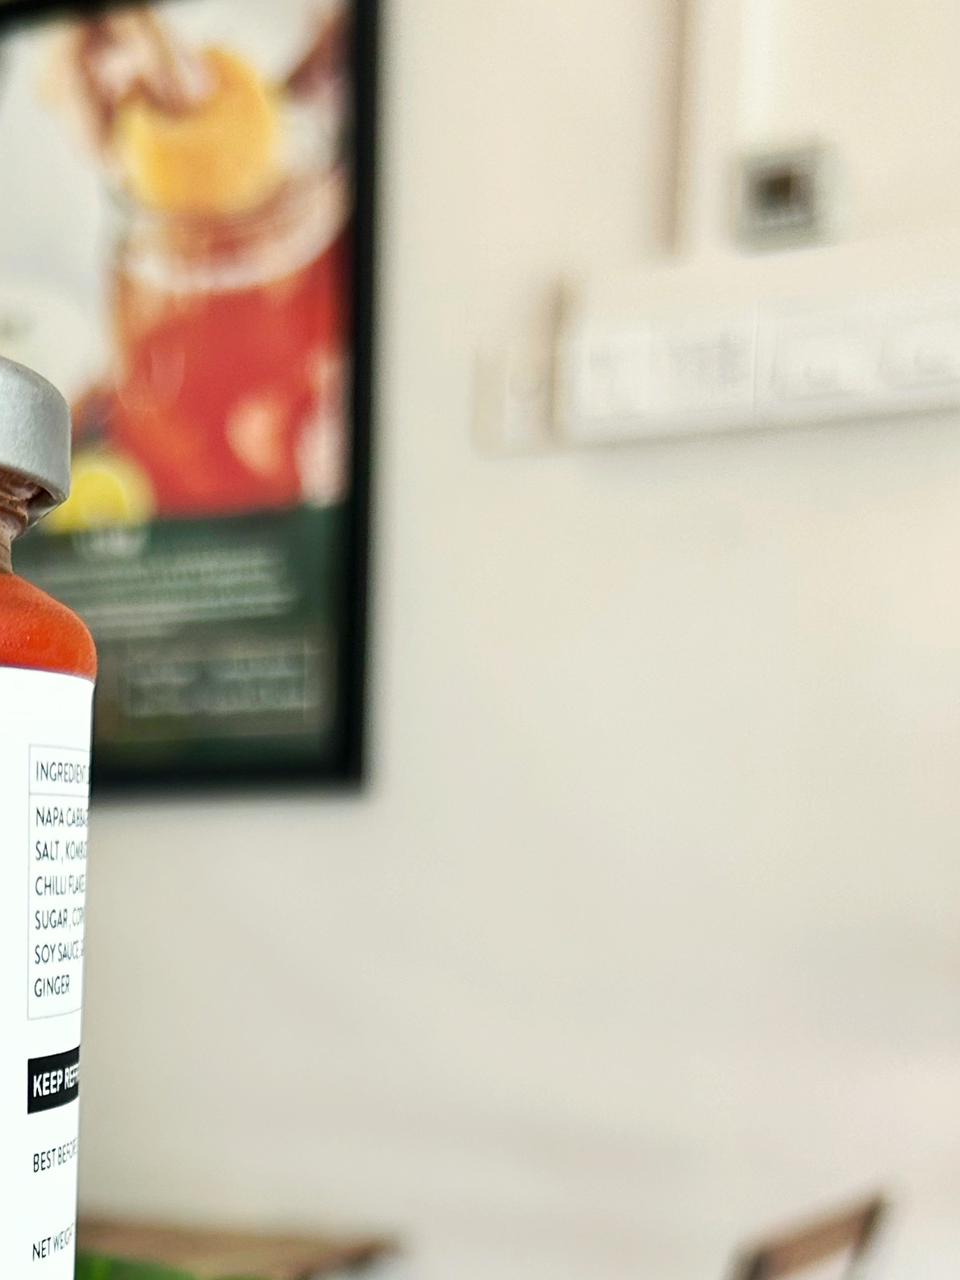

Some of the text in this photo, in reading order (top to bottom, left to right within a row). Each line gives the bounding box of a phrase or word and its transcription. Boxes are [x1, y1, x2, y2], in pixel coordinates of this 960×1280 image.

[35, 807, 64, 826] NAPA
[35, 876, 67, 895] CHILLI
[35, 944, 57, 964] SOY
[34, 974, 70, 997] GINGER
[33, 1069, 63, 1098] KEEP
[33, 1148, 56, 1173] BEST
[32, 1237, 51, 1262] NET
